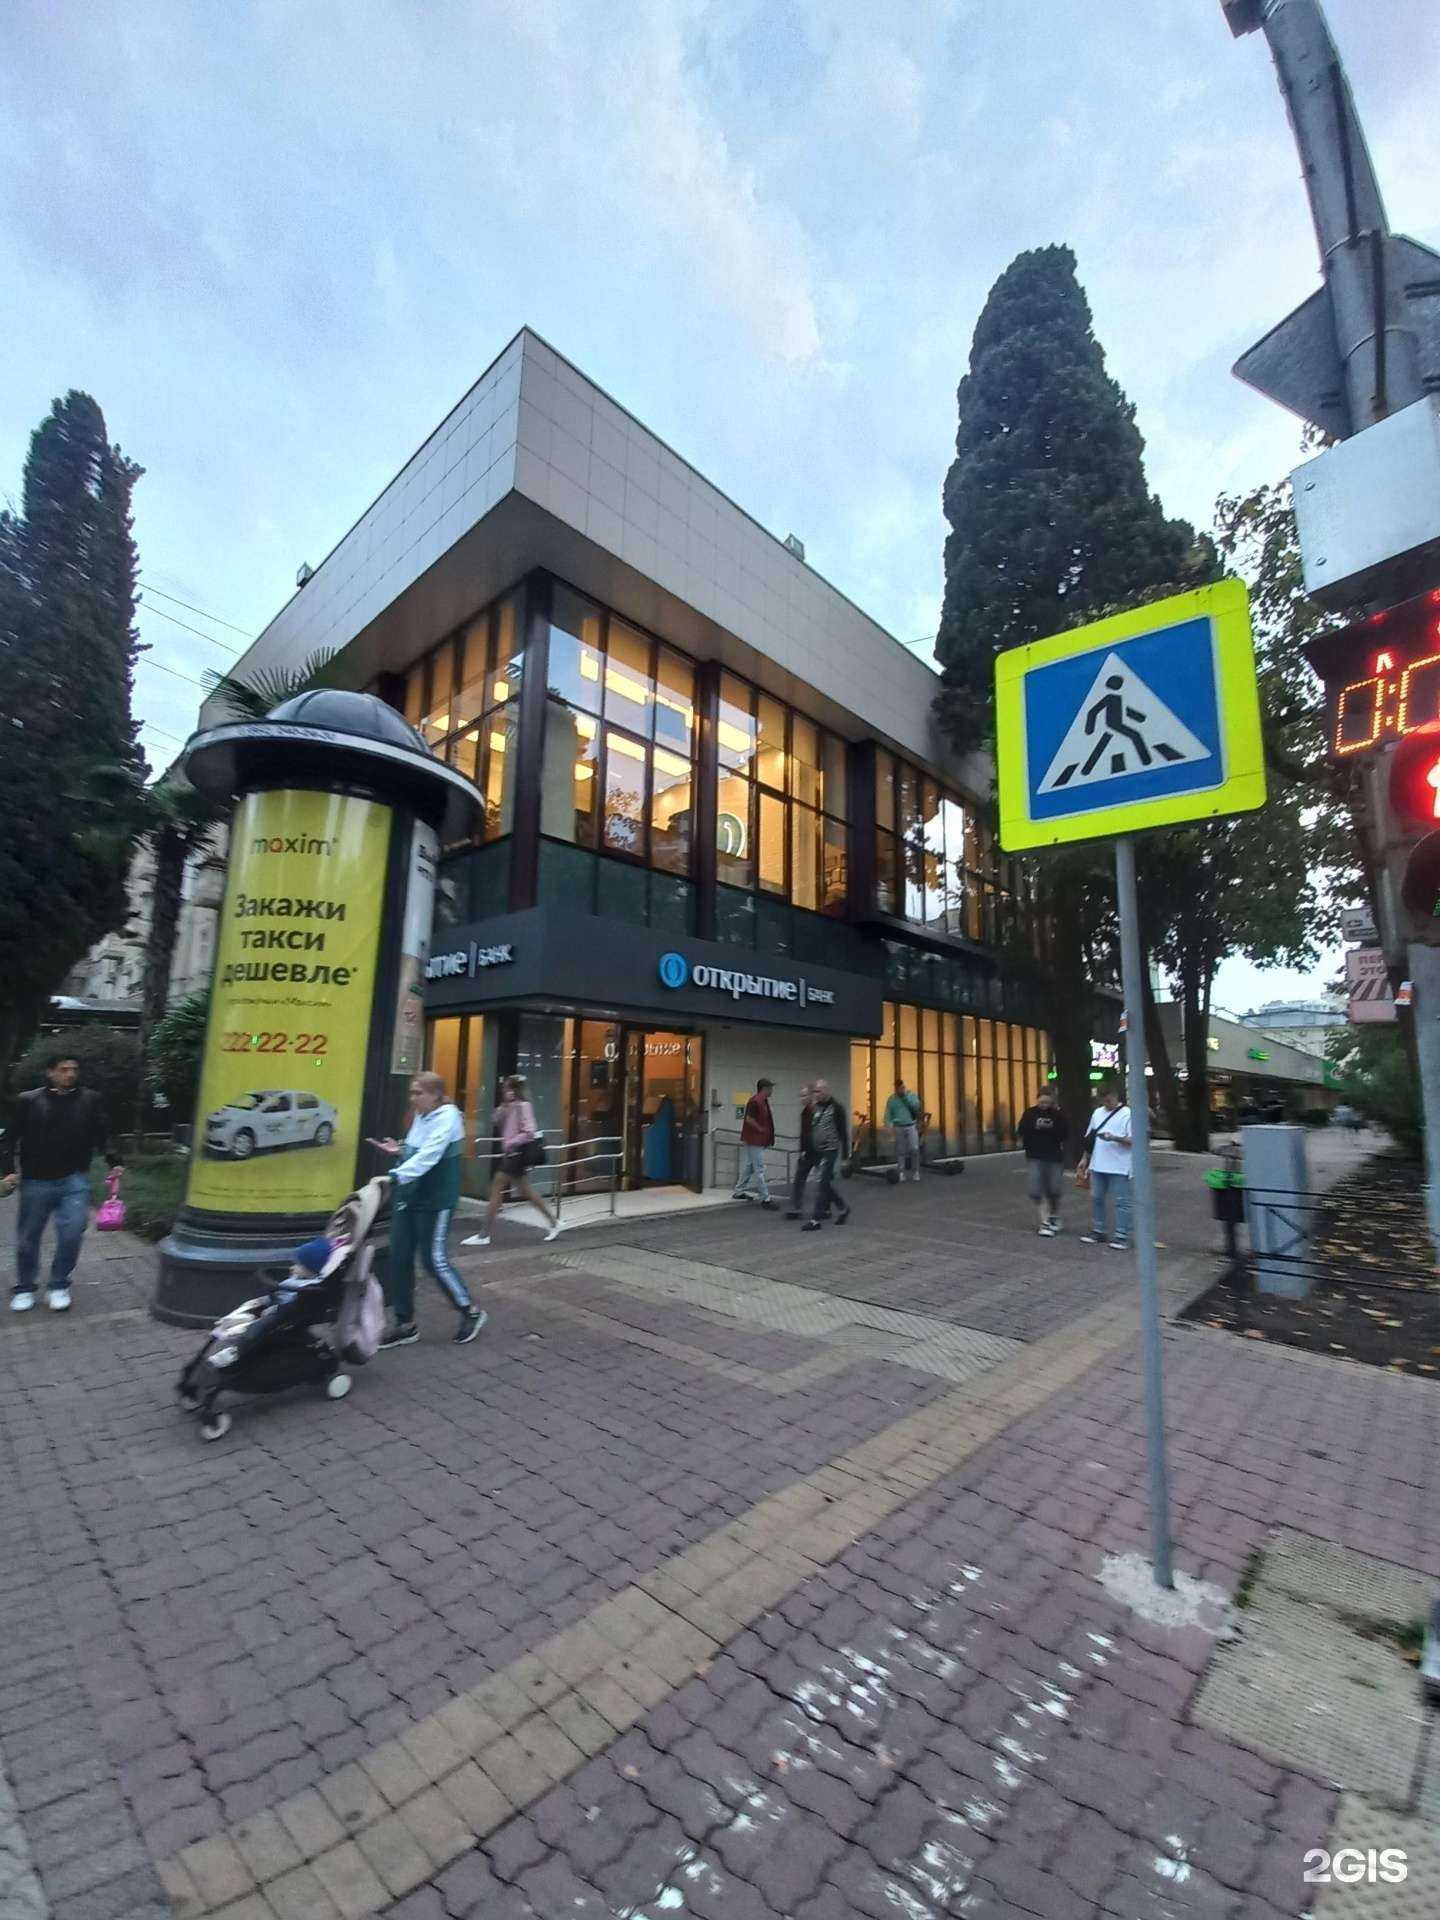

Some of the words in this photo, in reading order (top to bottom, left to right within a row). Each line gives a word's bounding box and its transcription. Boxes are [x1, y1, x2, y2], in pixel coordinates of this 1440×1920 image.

[251, 833, 332, 856] maxim
[233, 893, 347, 921] Закажи
[240, 930, 326, 951] такси
